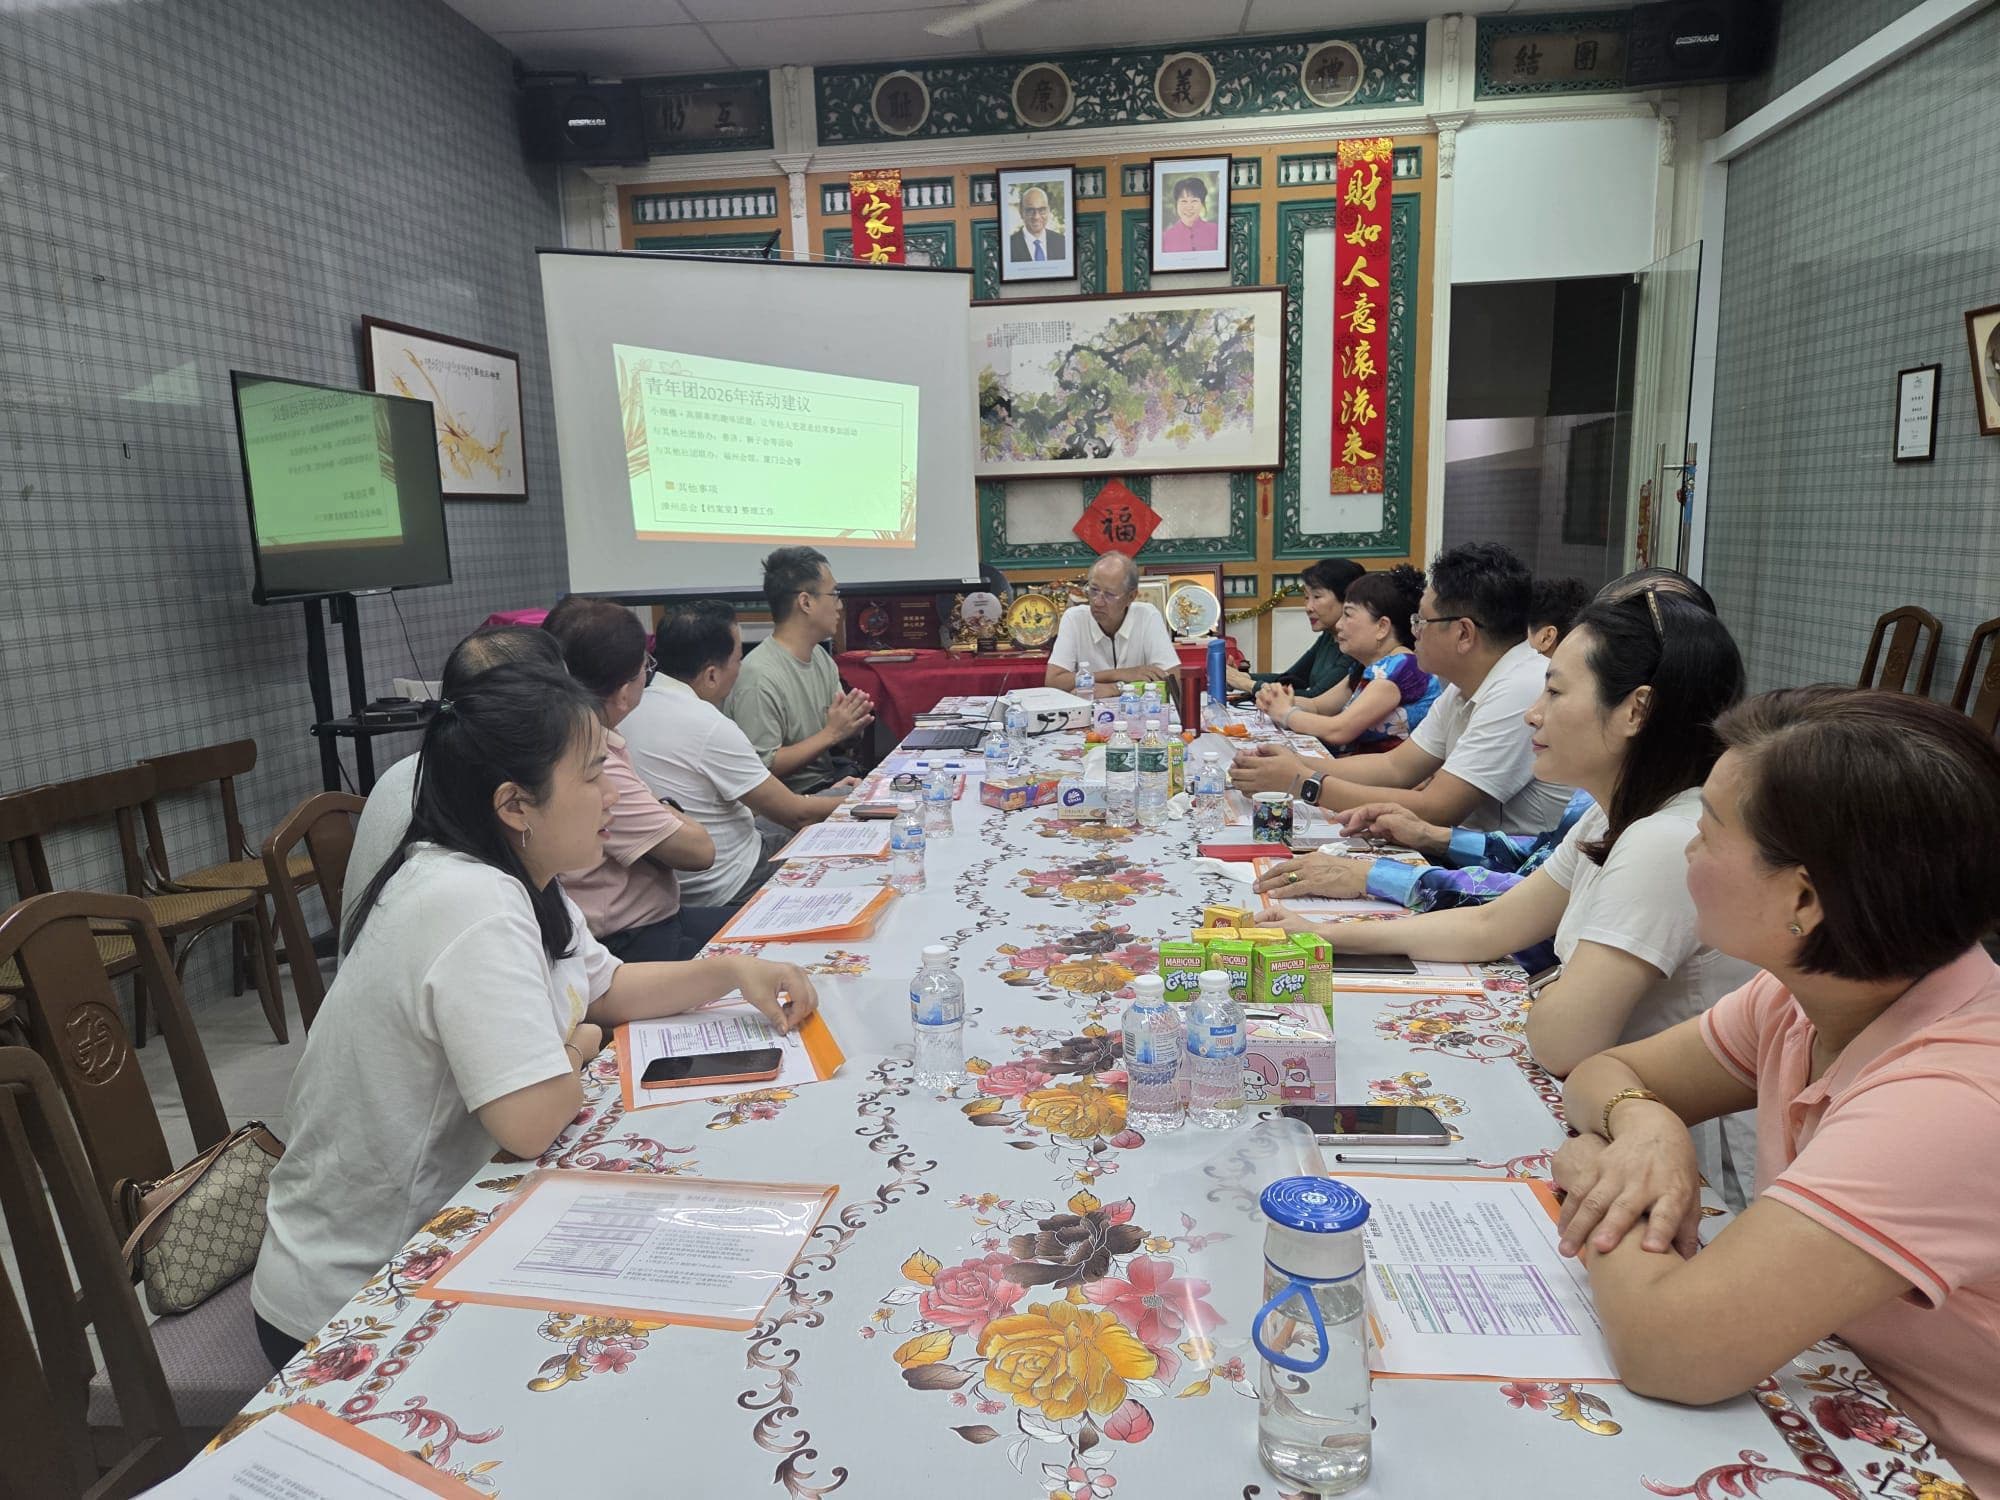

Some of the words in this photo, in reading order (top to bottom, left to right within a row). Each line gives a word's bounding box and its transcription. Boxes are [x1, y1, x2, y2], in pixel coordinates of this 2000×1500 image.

[1170, 68, 1195, 105] 義
[646, 377, 812, 413] 青年团2026年活动建议
[1101, 506, 1136, 543] 福
[1166, 957, 1200, 967] MARIGOLD
[1271, 960, 1304, 971] MARIGOLD
[1165, 972, 1200, 991] Green
[1181, 980, 1198, 990] Tea
[1272, 974, 1305, 995] Green
[1286, 983, 1302, 993] Tea
